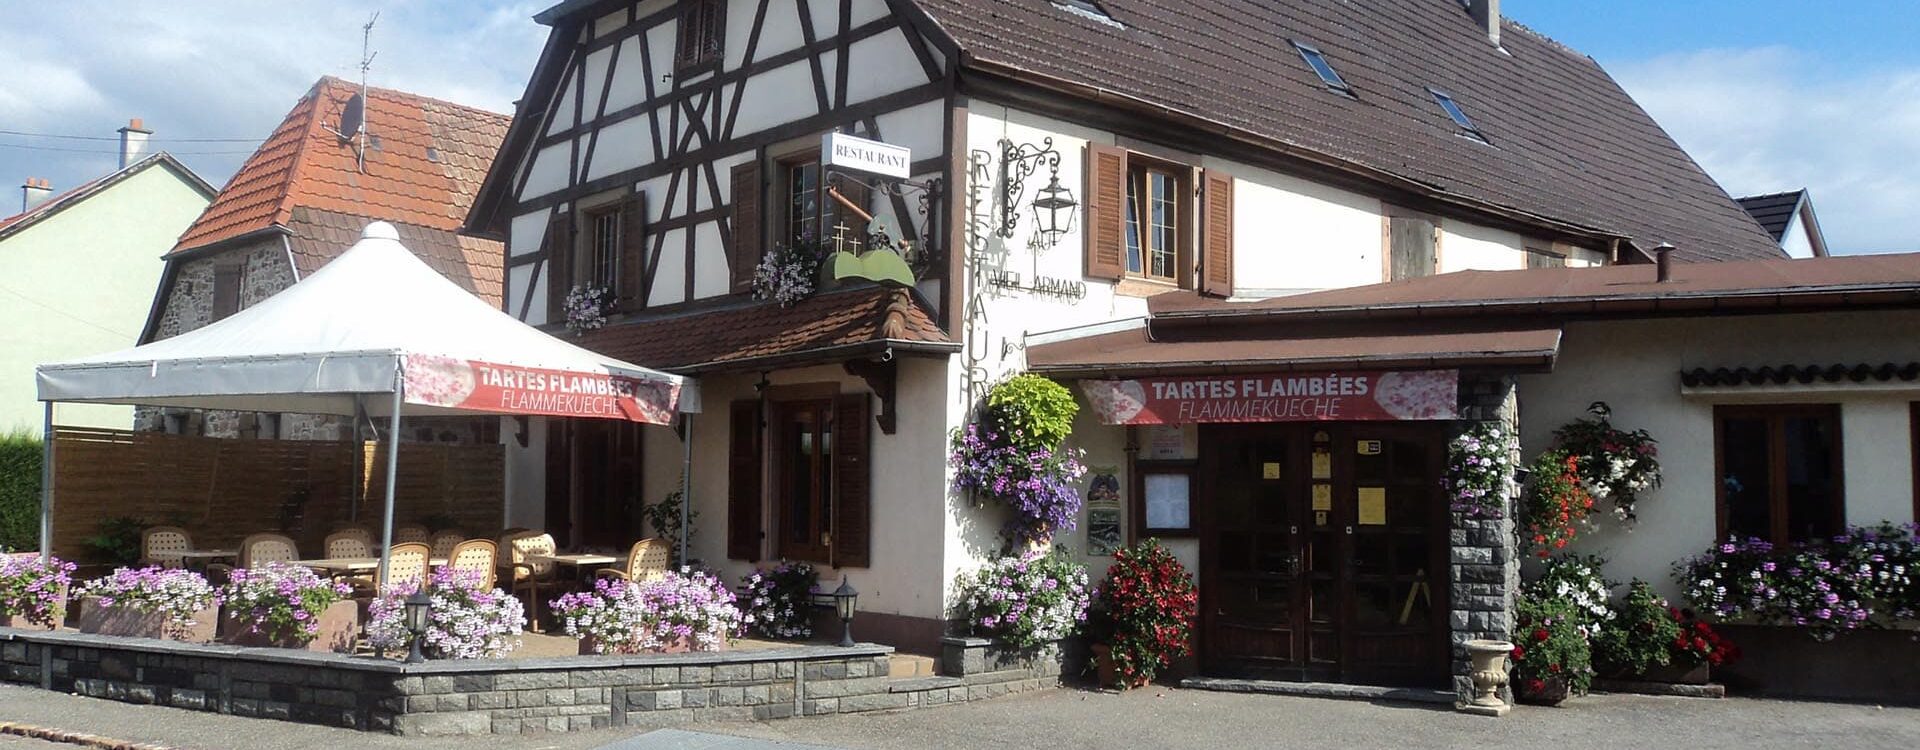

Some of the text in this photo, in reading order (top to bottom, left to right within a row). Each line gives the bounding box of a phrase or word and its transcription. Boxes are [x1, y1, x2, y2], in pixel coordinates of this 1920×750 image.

[835, 143, 907, 169] RESTAURANT
[1032, 229, 1051, 251] AU
[1034, 274, 1087, 301] ARMAND
[479, 367, 632, 398] TARTES FLAMBÉES
[1152, 374, 1368, 399] TARTES FLAMBÉES
[501, 390, 621, 415] FLAMMEKUECHE
[1178, 398, 1341, 419] FLAMMEKUECHE
